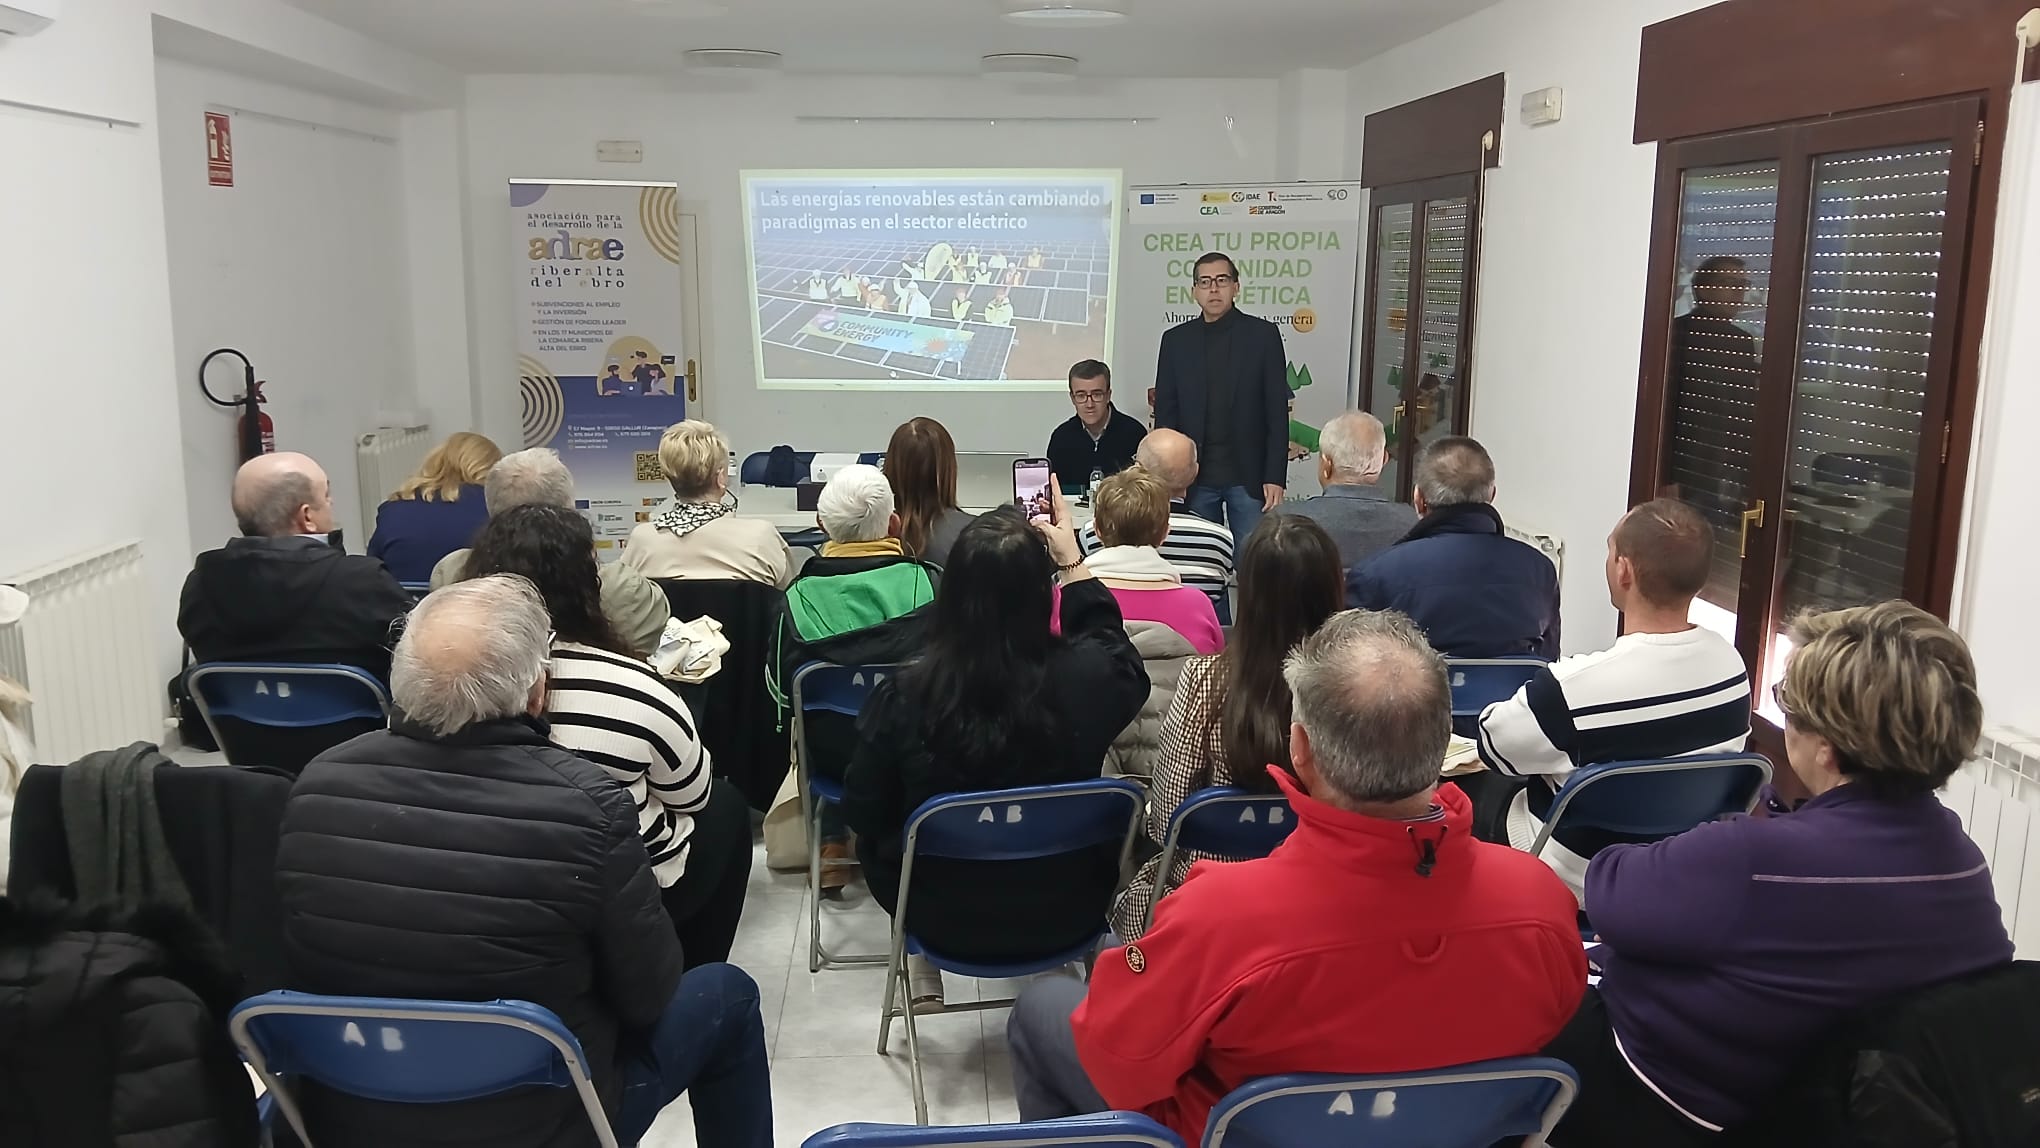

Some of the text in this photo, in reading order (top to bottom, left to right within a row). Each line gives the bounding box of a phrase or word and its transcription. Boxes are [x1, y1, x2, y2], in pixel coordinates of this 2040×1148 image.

[760, 189, 1100, 211] Las energías renovables están cambiando
[596, 214, 621, 222] para
[1200, 206, 1219, 215] CEA
[528, 220, 623, 229] el desarrollo de la
[762, 212, 1028, 234] paradigmas en el sector eléctrico
[528, 229, 624, 261] adrae
[1143, 231, 1341, 251] CREA TU PROPIA
[1167, 259, 1312, 278] CONIDAD
[531, 277, 562, 287] del
[1166, 281, 1311, 305] ENÉTICA
[1273, 315, 1313, 325] genera
[833, 321, 914, 343] COMMUNITY ENERGY
[852, 672, 865, 686] A
[256, 680, 290, 698] A B
[978, 805, 1022, 823] A B
[1239, 806, 1284, 824] A B
[343, 1021, 403, 1051] A B
[1327, 1091, 1397, 1116] A B
